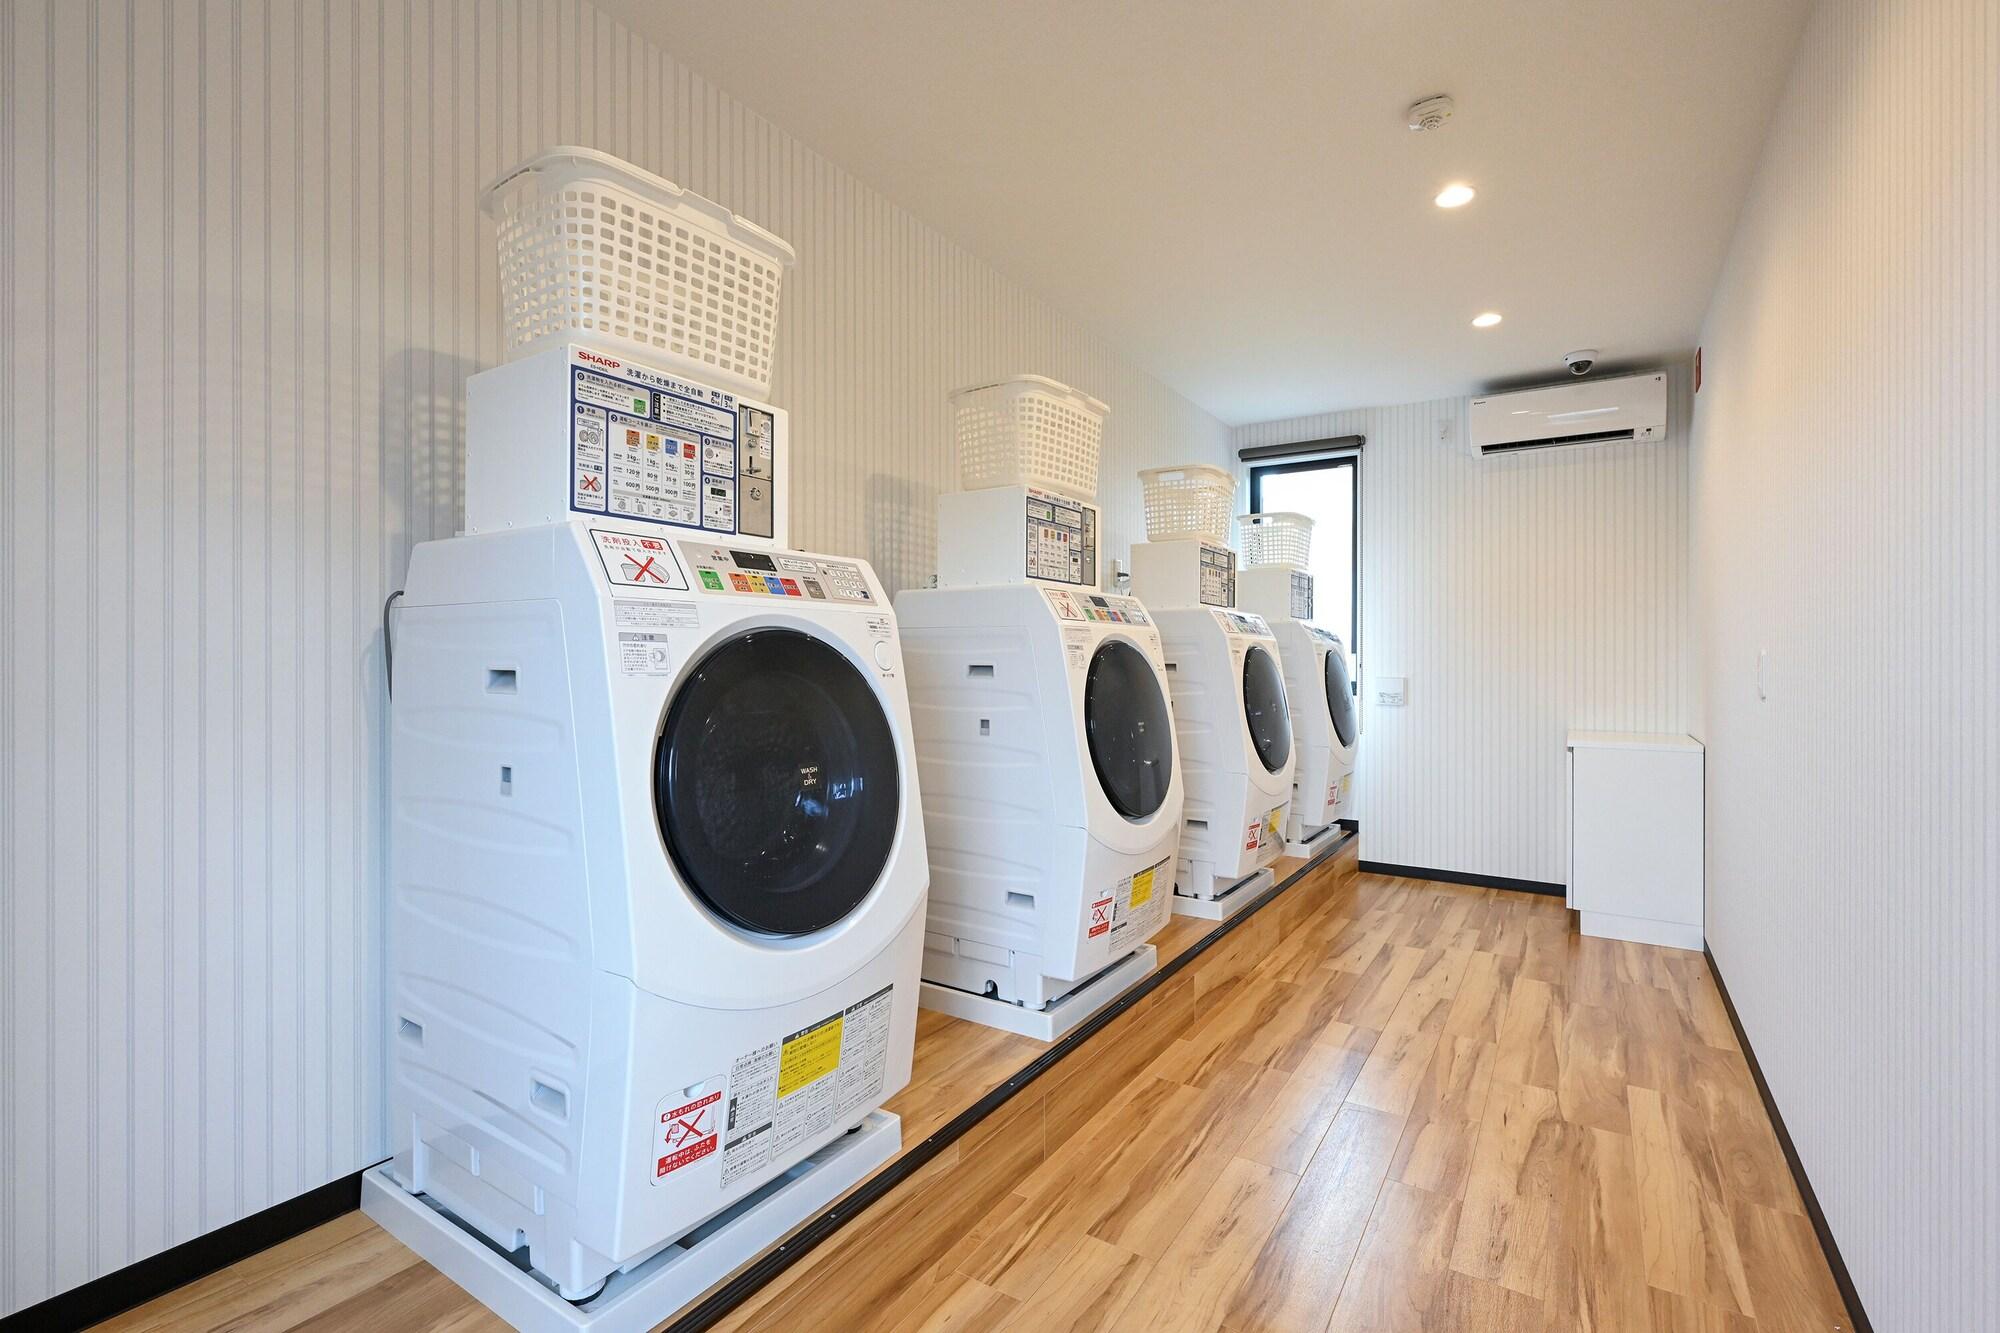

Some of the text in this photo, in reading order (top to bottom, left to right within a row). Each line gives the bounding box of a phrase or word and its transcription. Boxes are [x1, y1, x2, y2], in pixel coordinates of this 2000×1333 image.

[578, 351, 621, 369] SHARP
[626, 367, 704, 398] 洗濯から乾燥まで全自動
[601, 535, 641, 548] 洗剤投入
[800, 766, 818, 774] WASH
[671, 1093, 721, 1119] 水もれの恐れあり
[658, 1146, 716, 1175] 開けないでください。
[665, 1139, 712, 1165] 運転中は、ふたを
